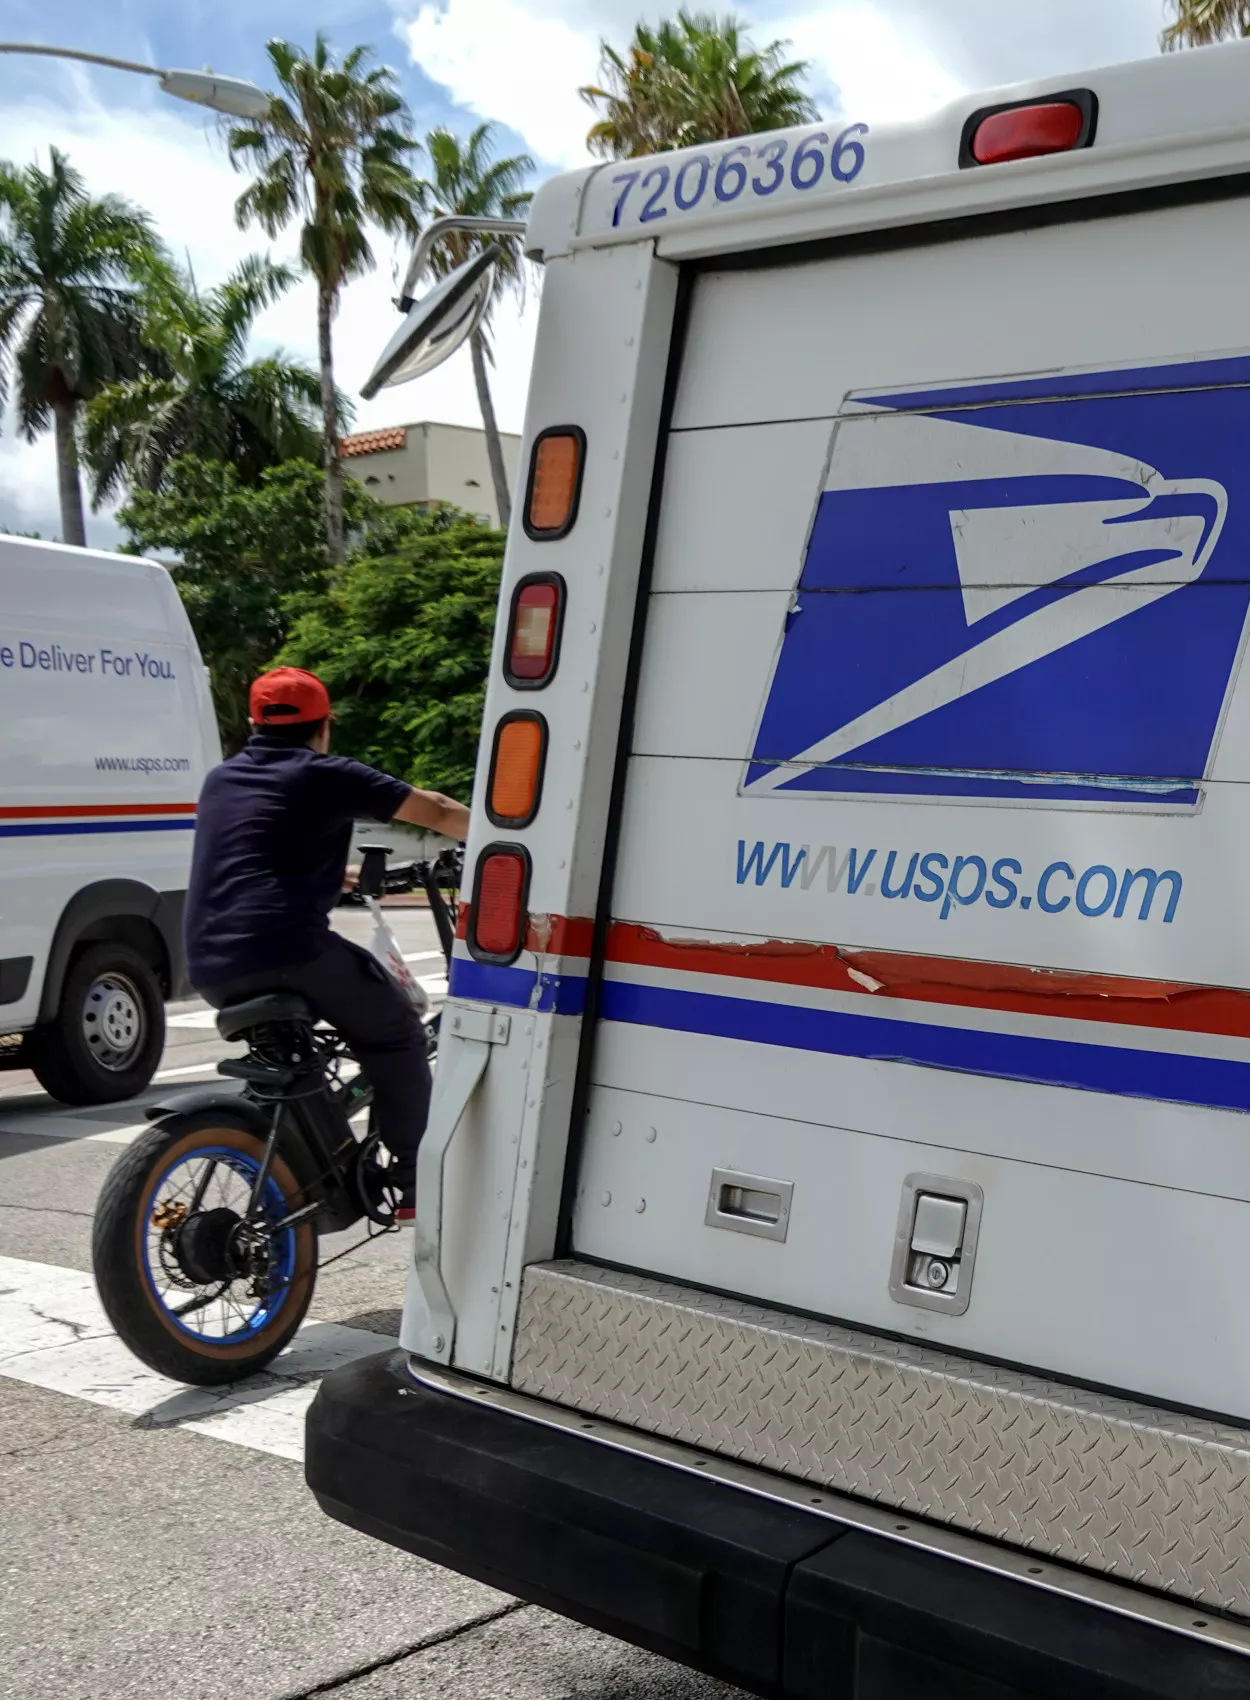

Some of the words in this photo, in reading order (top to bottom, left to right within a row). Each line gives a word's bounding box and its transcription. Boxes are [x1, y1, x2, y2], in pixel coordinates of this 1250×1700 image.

[611, 122, 870, 228] 7206366
[0, 645, 14, 668] e
[19, 642, 96, 674] Deliver
[99, 648, 133, 676] For
[135, 652, 176, 680] You.
[95, 757, 190, 775] www.usps.com
